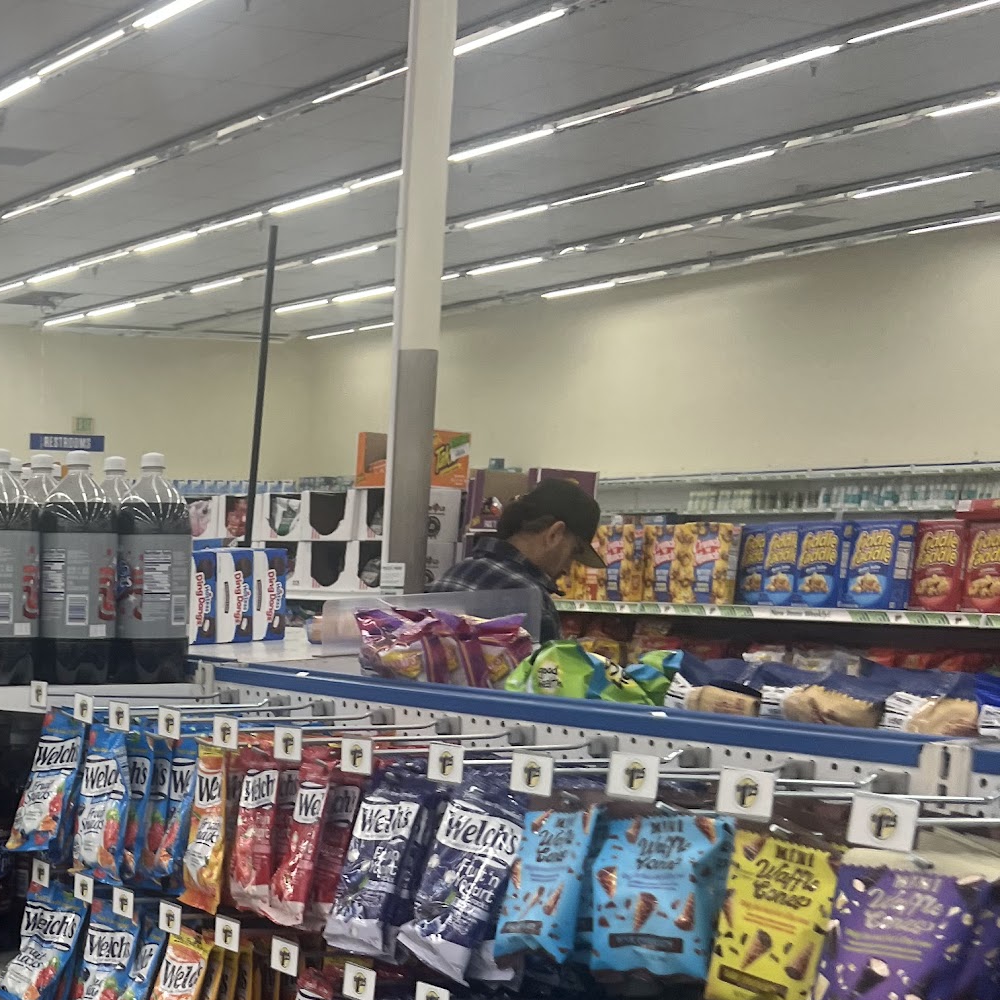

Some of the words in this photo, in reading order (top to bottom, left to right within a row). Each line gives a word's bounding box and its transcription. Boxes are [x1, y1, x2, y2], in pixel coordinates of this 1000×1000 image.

[196, 573, 204, 596] Ding
[234, 573, 242, 595] Ding
[267, 571, 275, 592] Ding
[196, 597, 205, 626] Dongs
[234, 595, 243, 624] Dongs
[266, 593, 276, 622] Dongs
[34, 741, 77, 766] Welch
[447, 815, 520, 856] Welch's
[775, 844, 815, 868] MINI
[755, 858, 820, 892] Waffle
[24, 910, 77, 939] Welch's
